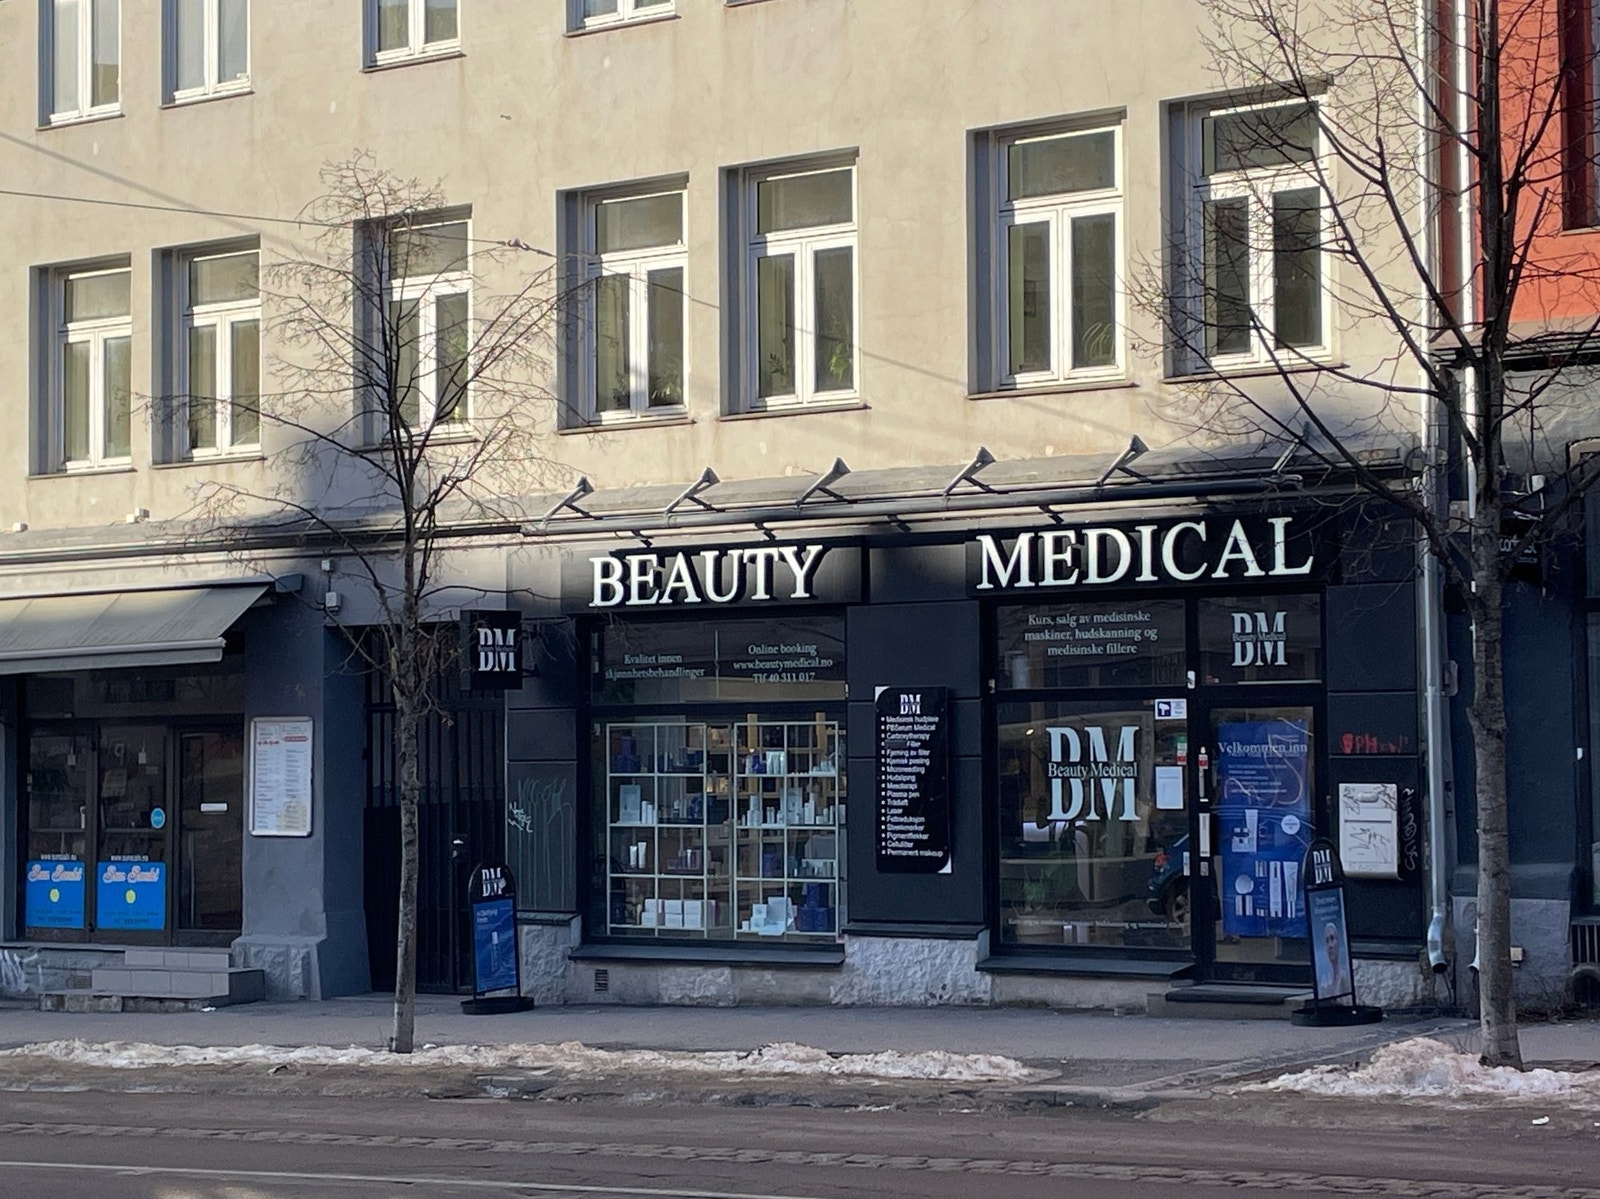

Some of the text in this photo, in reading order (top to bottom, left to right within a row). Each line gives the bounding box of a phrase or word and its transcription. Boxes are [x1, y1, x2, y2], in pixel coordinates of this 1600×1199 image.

[976, 517, 1314, 589] MEDICAL
[588, 544, 824, 608] BEAUTY
[1028, 610, 1151, 627] Kurs, salg av medisinske
[1025, 626, 1158, 642] maskiner, hudskanning og
[1257, 631, 1287, 642] Medical
[748, 642, 817, 656] Online booking
[1047, 641, 1138, 656] medisinske fillere
[624, 653, 683, 665] Kvalitet innen
[733, 657, 833, 672] www.beautymedical.no
[768, 673, 780, 683] 40
[780, 673, 797, 683] 311
[798, 672, 816, 682] 017
[1218, 741, 1288, 754] Velkommen
[1049, 762, 1138, 780] Beauty Medical
